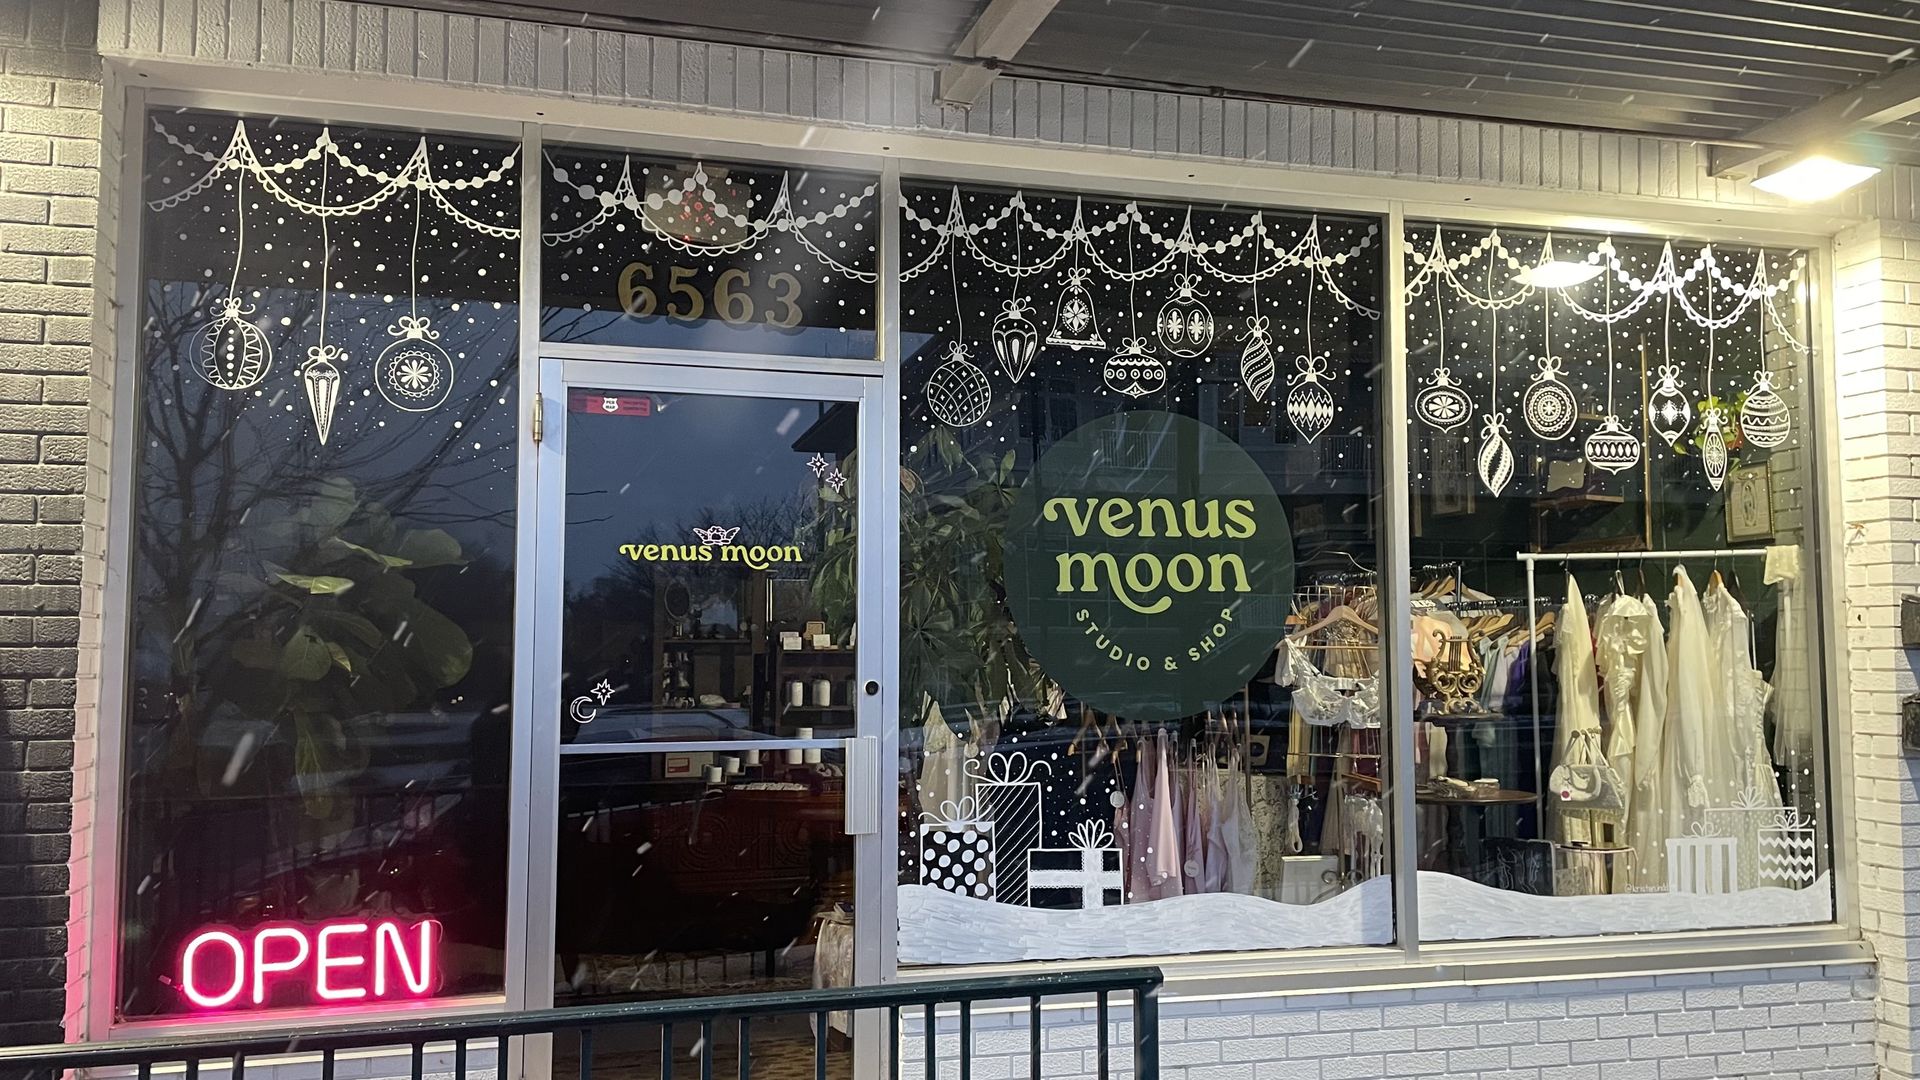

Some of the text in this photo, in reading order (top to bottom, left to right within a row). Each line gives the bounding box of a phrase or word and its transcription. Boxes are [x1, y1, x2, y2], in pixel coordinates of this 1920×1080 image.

[617, 262, 803, 328] 6563
[1043, 497, 1257, 538] venus
[619, 544, 803, 570] venus moon
[1056, 552, 1251, 614] moon
[1076, 608, 1233, 671] STUDIO & SHOP
[183, 920, 430, 1007] OPEN
